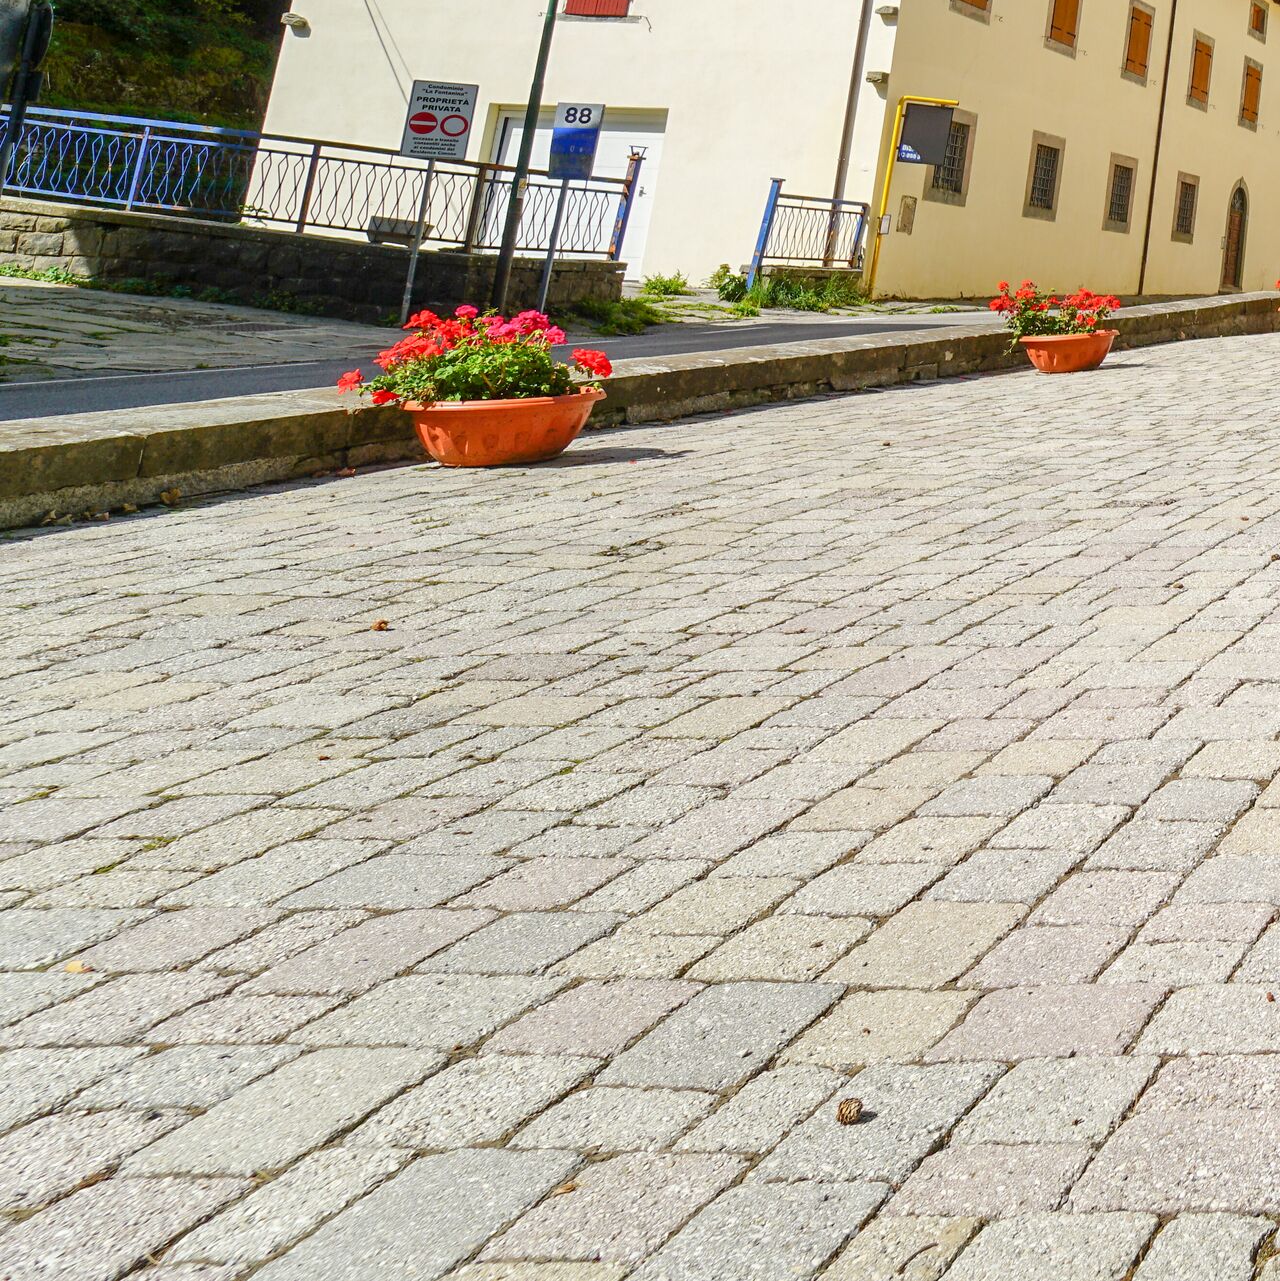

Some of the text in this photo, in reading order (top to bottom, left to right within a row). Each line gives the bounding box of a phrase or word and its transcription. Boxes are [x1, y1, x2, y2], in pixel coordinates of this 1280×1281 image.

[416, 96, 470, 106] PROPRIETÀ
[422, 104, 461, 113] PRIVATA
[564, 107, 592, 124] 88
